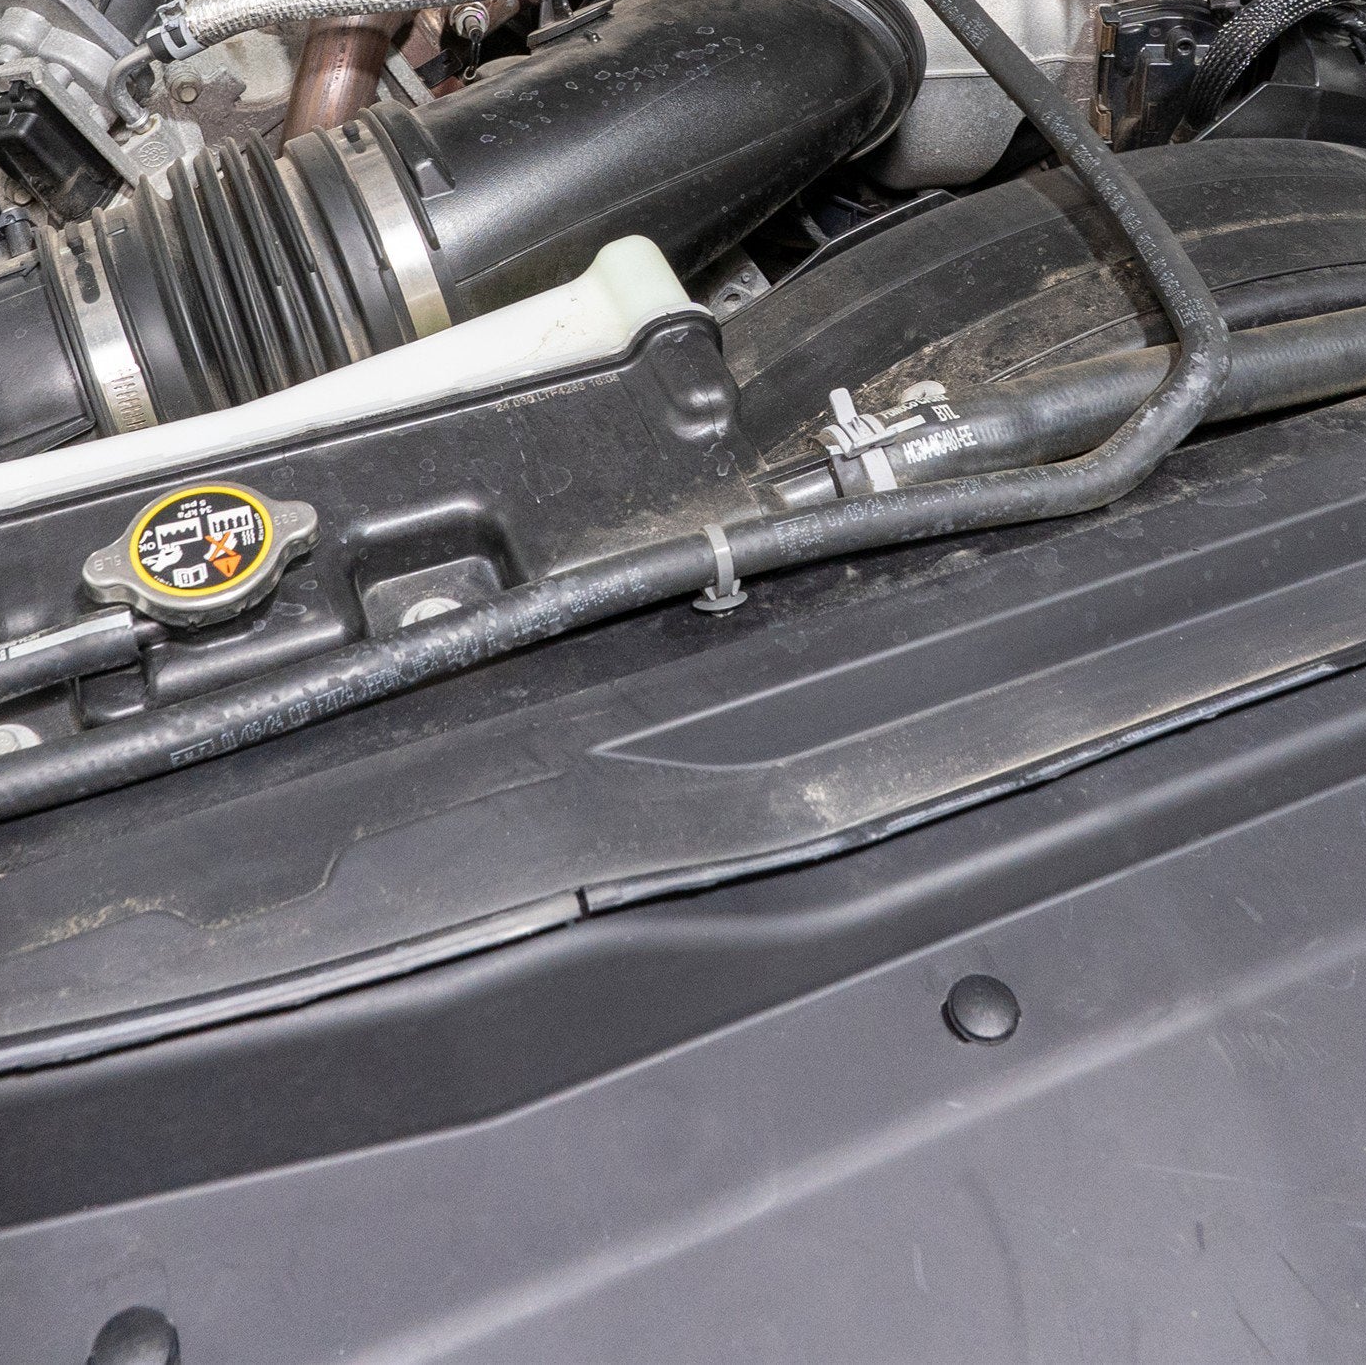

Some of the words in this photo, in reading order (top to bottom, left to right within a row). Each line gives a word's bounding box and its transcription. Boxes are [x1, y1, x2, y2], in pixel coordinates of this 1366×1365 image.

[931, 403, 960, 421] BTL
[180, 500, 197, 510] psi
[177, 509, 198, 519] kPa
[138, 542, 156, 552] OK
